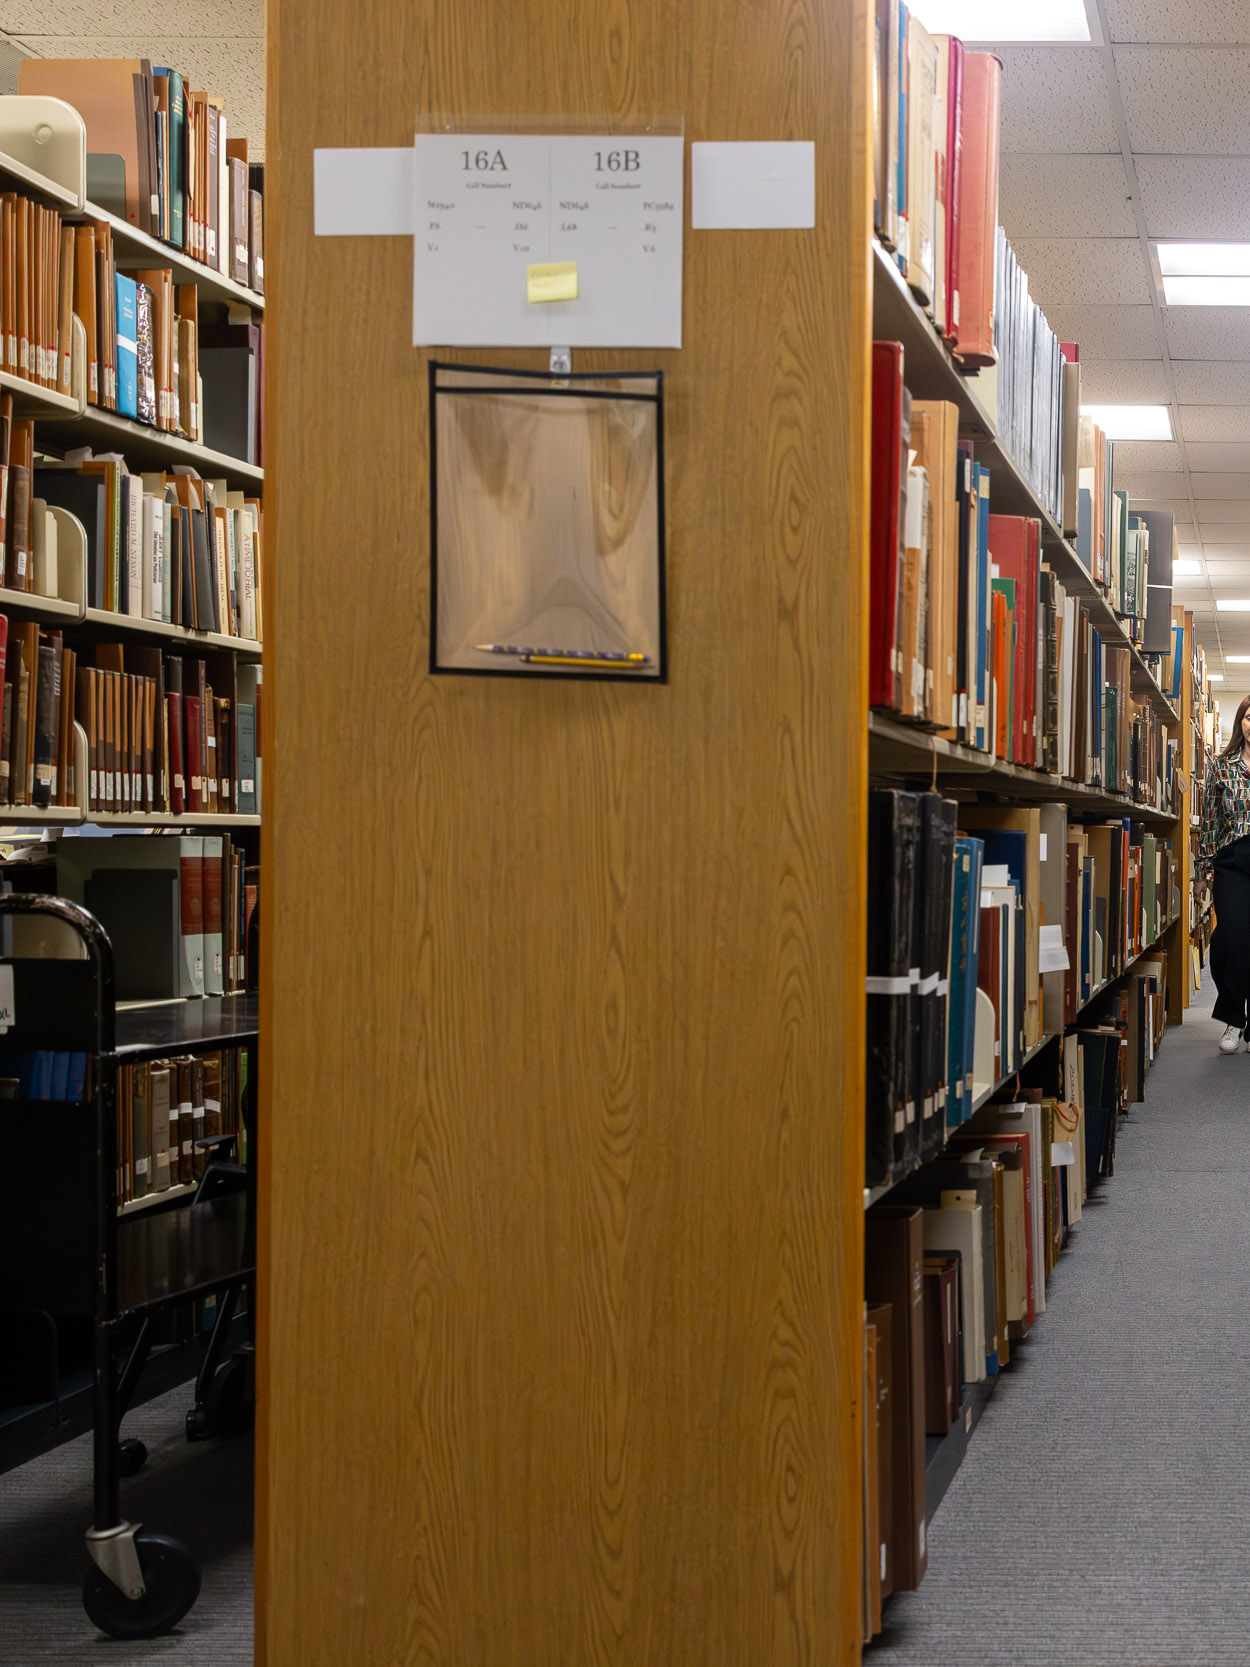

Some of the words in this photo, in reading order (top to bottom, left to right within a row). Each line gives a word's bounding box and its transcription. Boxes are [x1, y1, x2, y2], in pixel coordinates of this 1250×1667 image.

[462, 149, 508, 171] 16A
[594, 149, 641, 171] 16B
[130, 494, 138, 537] RICHARD
[243, 534, 251, 542] A
[130, 548, 138, 580] NIXON
[244, 566, 251, 577] TO
